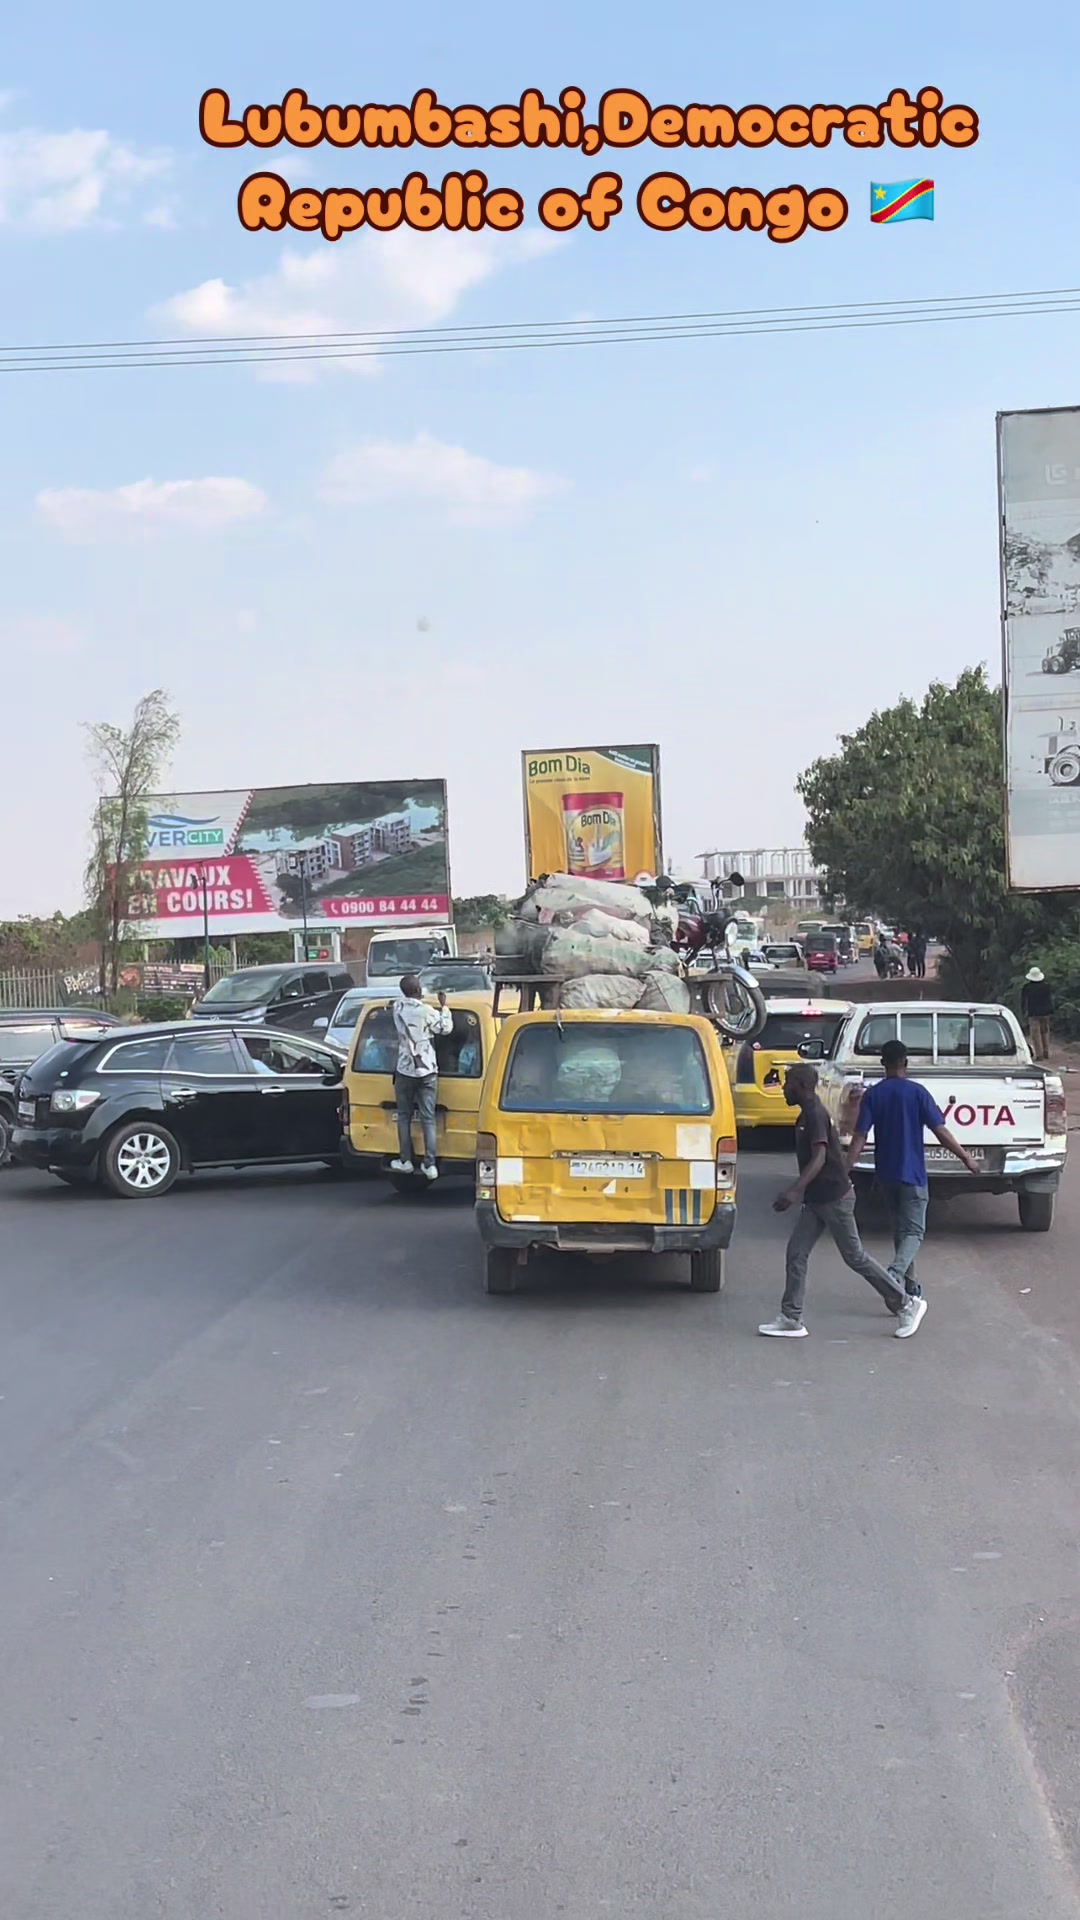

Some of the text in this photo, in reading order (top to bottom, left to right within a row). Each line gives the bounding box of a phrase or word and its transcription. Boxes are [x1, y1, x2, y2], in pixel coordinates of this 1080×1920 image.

[529, 758, 562, 777] Bom
[565, 755, 591, 774] Dia
[581, 813, 602, 827] Bom
[129, 865, 231, 890] TRAVAUX
[167, 888, 253, 913] COURS!
[341, 898, 438, 914] 0900 84 44 44
[941, 1104, 1015, 1126] YOTA
